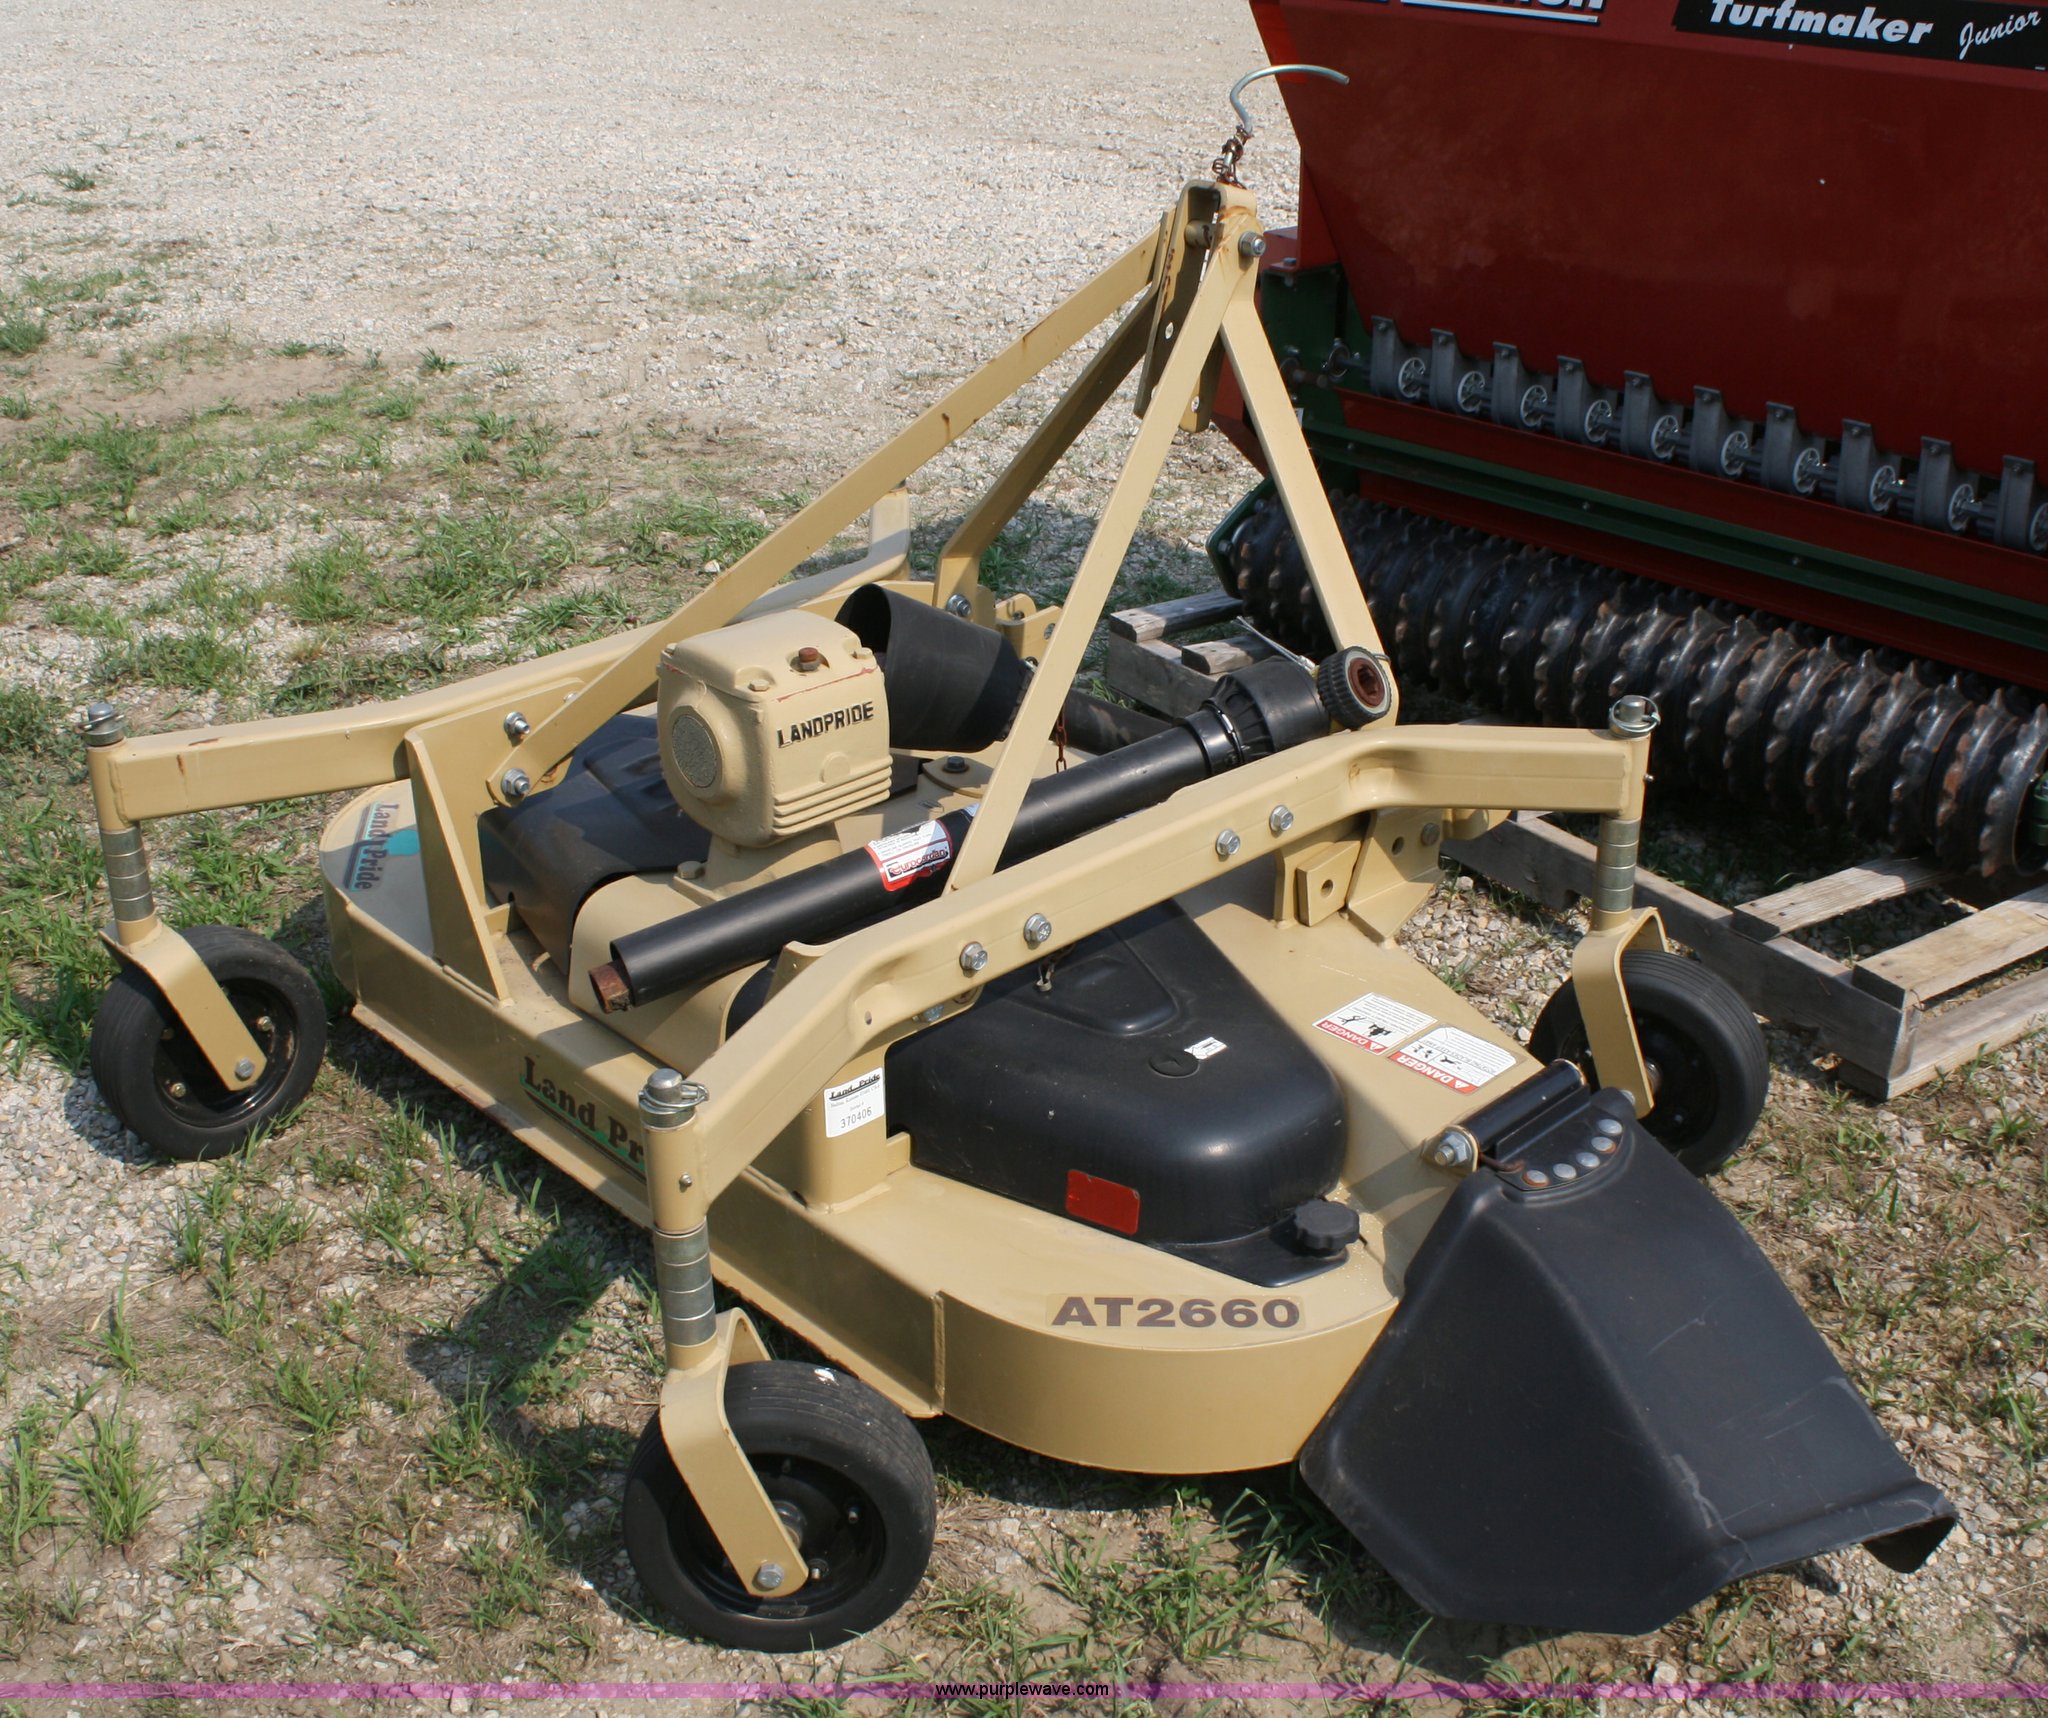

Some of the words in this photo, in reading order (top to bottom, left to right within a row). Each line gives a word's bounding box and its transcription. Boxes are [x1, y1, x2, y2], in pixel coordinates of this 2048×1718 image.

[1710, 0, 1934, 45] Turfmaker
[1959, 10, 2041, 60] Junior
[776, 700, 874, 748] LANDPRIDE
[367, 802, 400, 838] Land
[353, 848, 388, 890] Pride
[1321, 1021, 1369, 1045] DANGER
[1396, 1054, 1455, 1083] DANGER
[524, 1056, 595, 1131] Land
[830, 1085, 853, 1099] Land
[1051, 1296, 1300, 1328] AT2660
